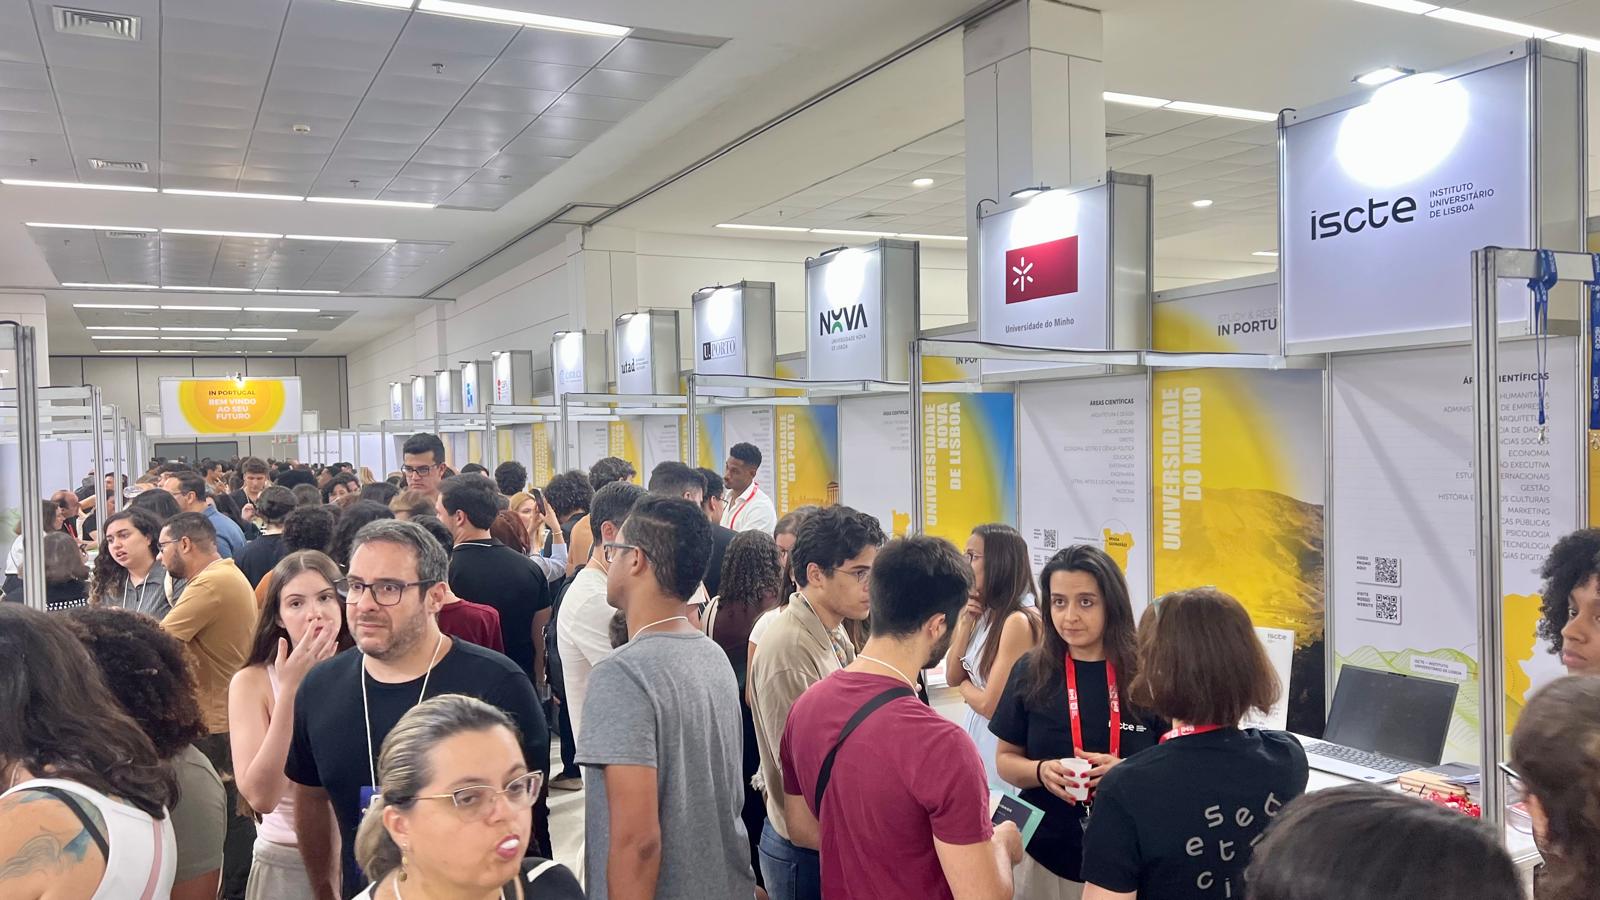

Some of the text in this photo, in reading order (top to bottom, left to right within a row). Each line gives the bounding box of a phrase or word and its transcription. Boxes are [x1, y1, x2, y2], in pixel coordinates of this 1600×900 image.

[1429, 182, 1474, 199] INSTITUTO
[1429, 188, 1495, 208] UNIVERSITÁRIO
[1311, 196, 1417, 241] iscte
[1429, 203, 1475, 218] DE LISBOA
[820, 303, 868, 336] NOVA
[1005, 317, 1075, 333] Universidade do Minho
[1217, 318, 1277, 336] IN PORTU
[621, 357, 636, 374] utad
[1498, 371, 1550, 383] IENTÍFICAS
[208, 398, 228, 406] BEM
[217, 405, 249, 413] AO SEU
[216, 413, 251, 421] FUTURO
[937, 402, 949, 449] NOVA
[1523, 425, 1550, 433] DADS
[787, 413, 797, 482] DO PORTO
[949, 401, 961, 491] DE LISBOA
[1183, 387, 1202, 500] DO MINHO
[1508, 449, 1551, 457] ECONOMIA
[780, 413, 789, 513] UNIVERSIDADE
[925, 402, 937, 526] UNIVERSIDADE
[1162, 387, 1181, 550] UNIVERSIDADE
[1510, 461, 1551, 469] EXECUTIVA
[1520, 483, 1551, 492] GESTÃO
[1510, 495, 1551, 503] CULTURAIS
[1508, 506, 1551, 515] MARKETING
[1505, 529, 1551, 538] PSICOLOGIA
[1504, 540, 1551, 550] TECNOLOGIA
